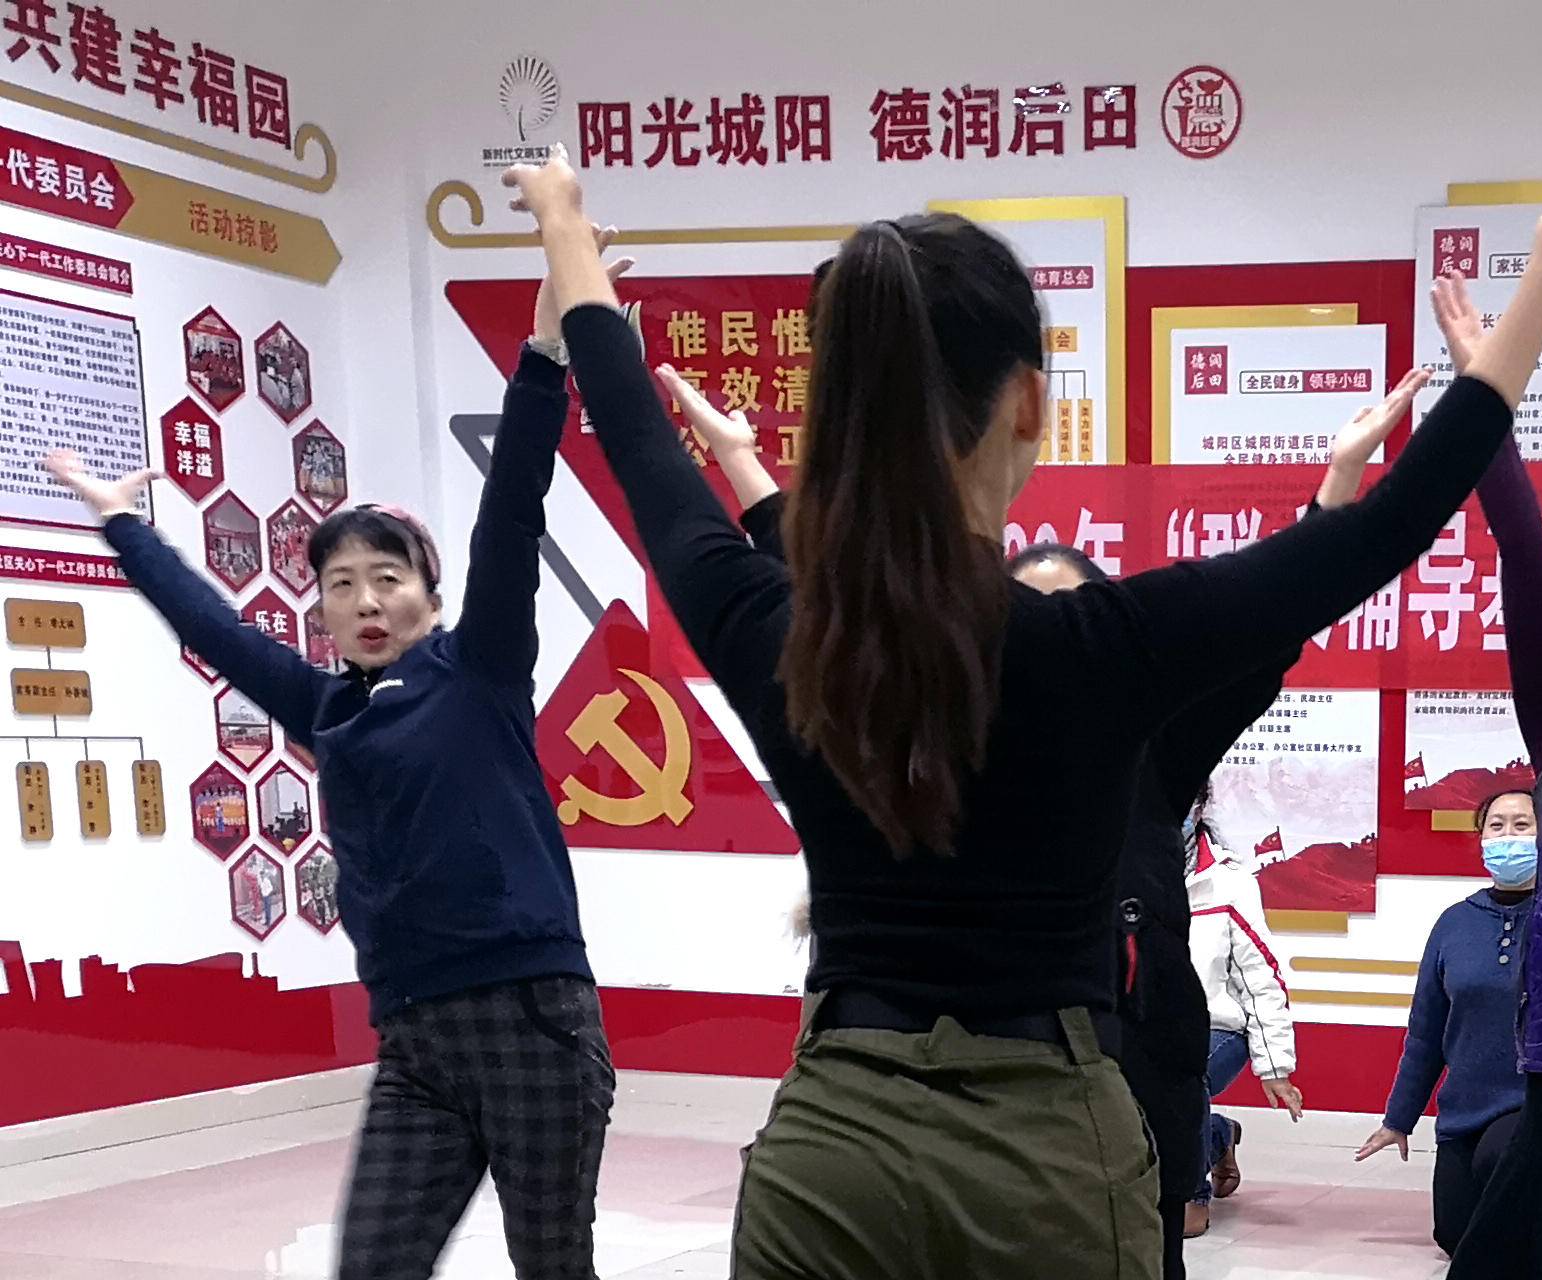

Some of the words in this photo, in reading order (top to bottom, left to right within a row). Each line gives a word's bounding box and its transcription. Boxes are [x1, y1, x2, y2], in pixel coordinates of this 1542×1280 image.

[3, 0, 292, 150] 共建幸福园
[579, 93, 833, 169] 阳光城阳
[868, 84, 1137, 162] 德润后田
[483, 146, 551, 160] 新时代文明实
[0, 148, 115, 210] 代委员会
[189, 200, 279, 254] 活动掠影
[1033, 269, 1090, 287] 体育总会
[1496, 256, 1531, 275] 家长
[1246, 373, 1300, 390] 全民健身
[1309, 370, 1368, 389] 领导小组
[174, 421, 211, 450] 幸福
[1202, 434, 1337, 451] 城阳区城阳街道后田
[254, 609, 289, 634] 乐在
